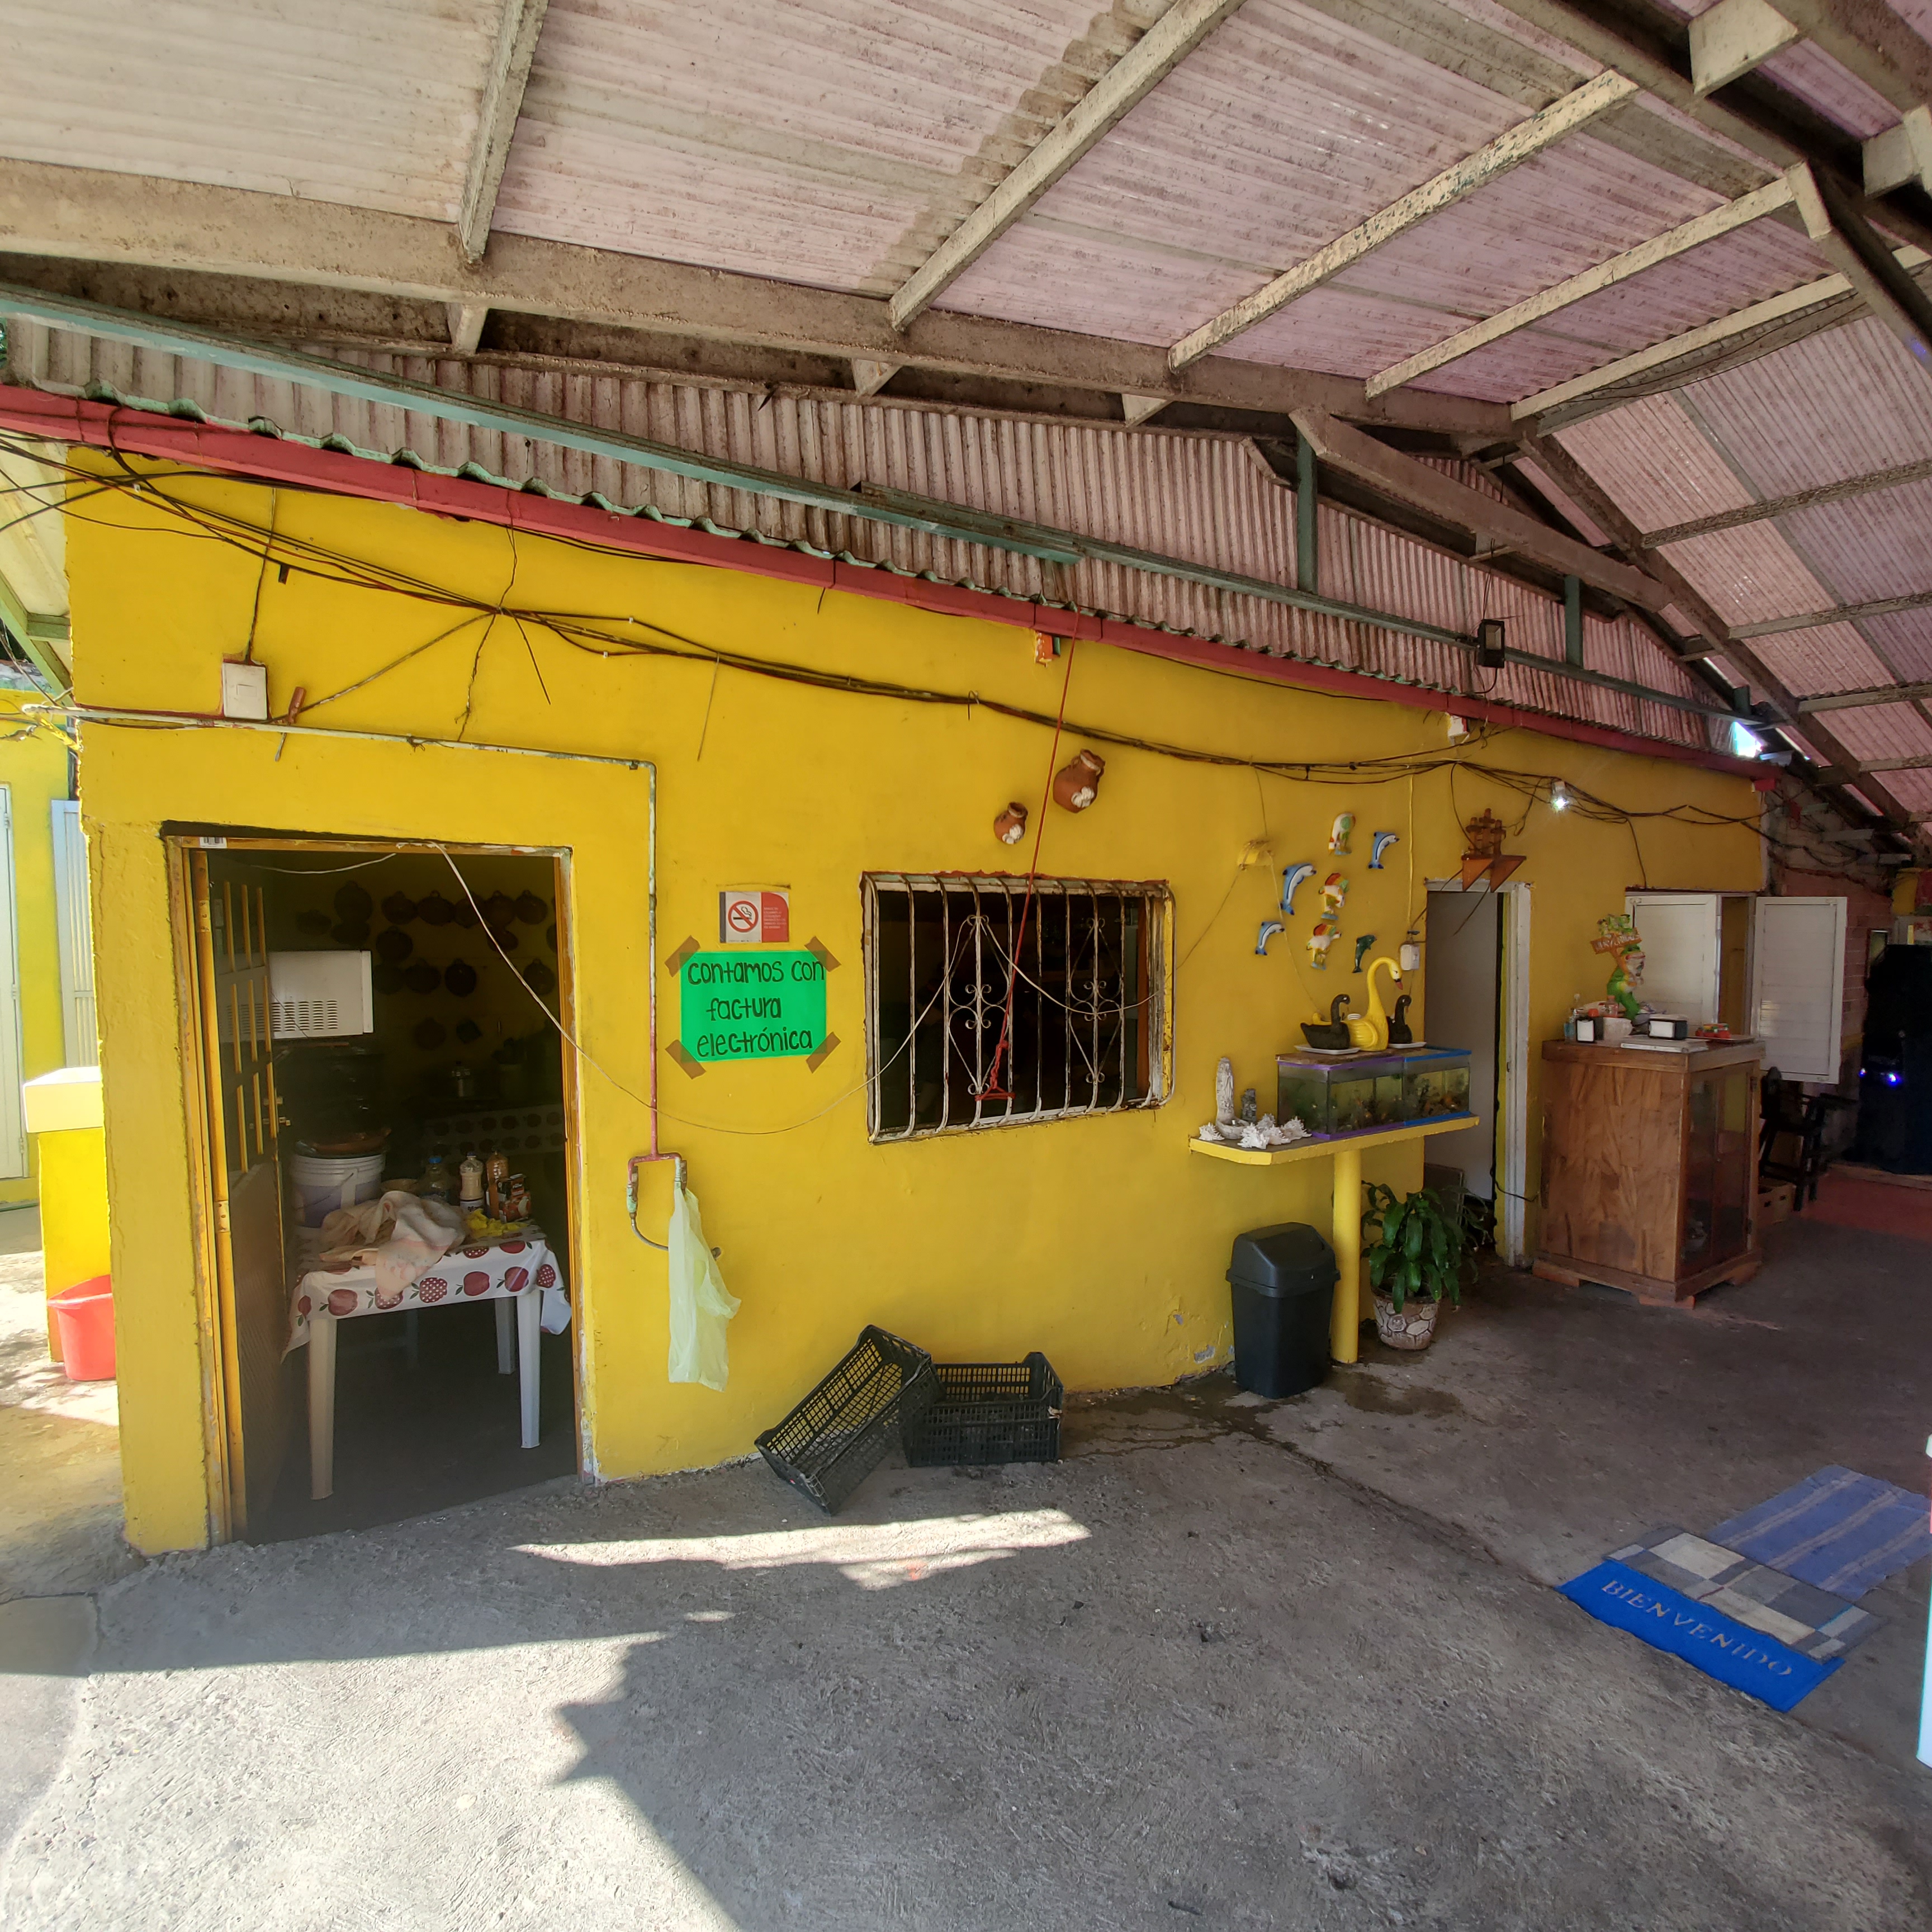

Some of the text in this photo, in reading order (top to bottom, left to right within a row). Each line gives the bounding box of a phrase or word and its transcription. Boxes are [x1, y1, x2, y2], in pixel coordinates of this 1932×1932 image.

[791, 960, 825, 982] con
[706, 997, 782, 1021] factura
[697, 1026, 813, 1057] electrónica
[1602, 1580, 1792, 1675] BIENVENIDO
